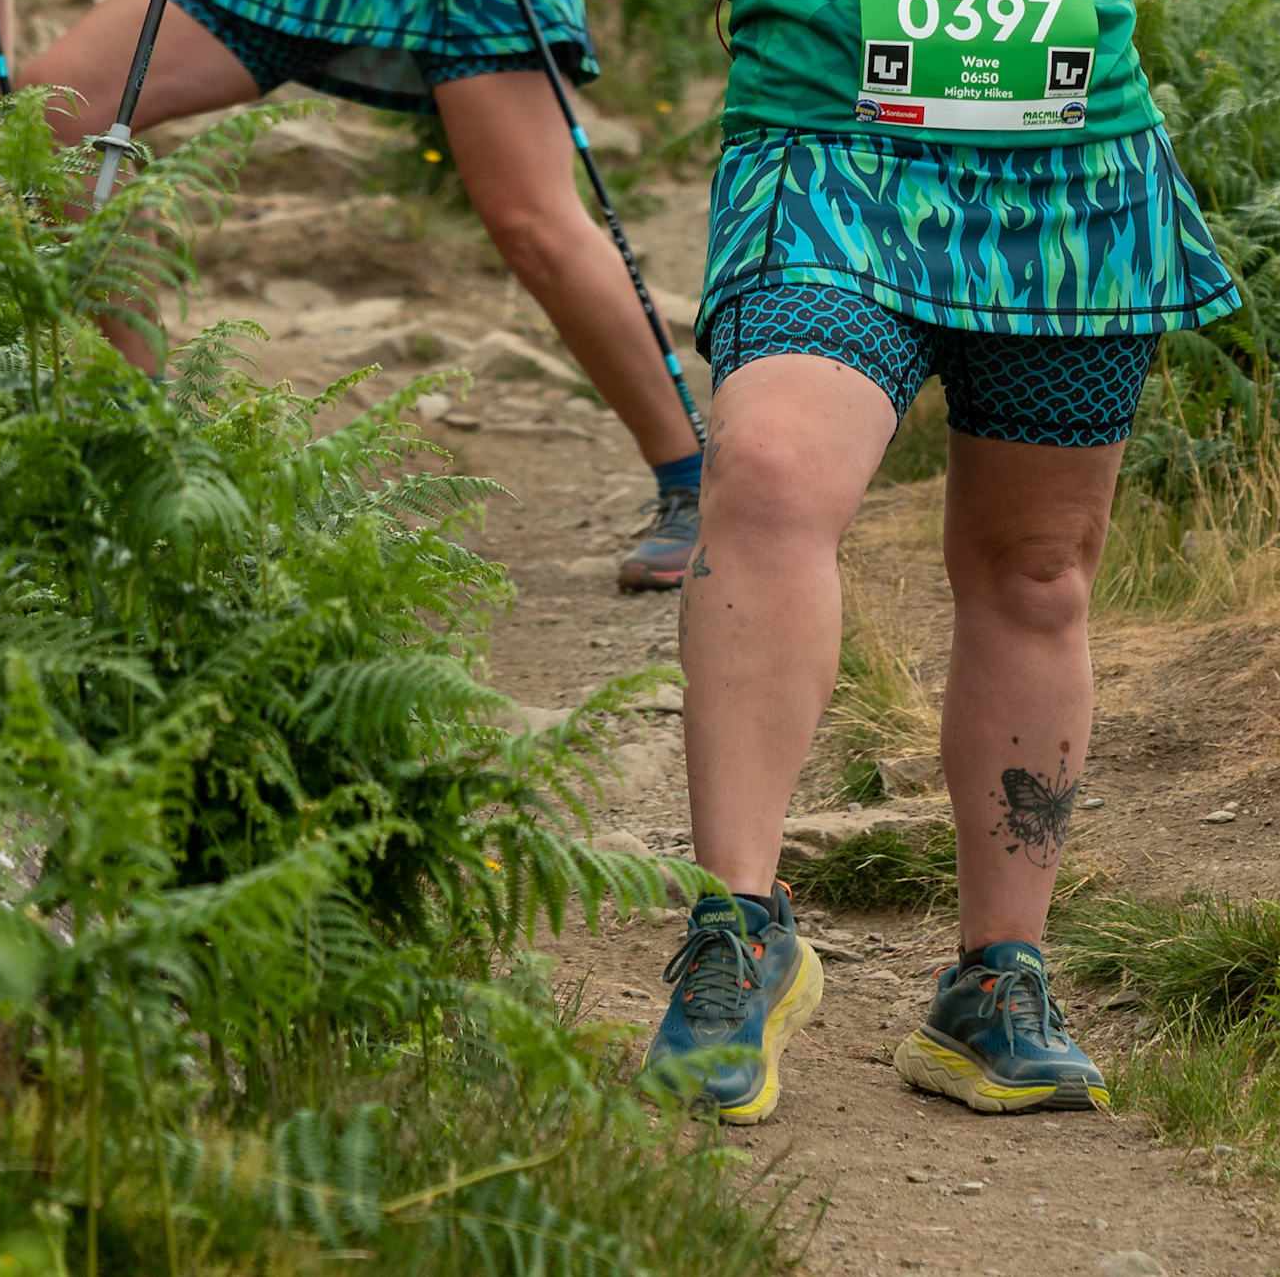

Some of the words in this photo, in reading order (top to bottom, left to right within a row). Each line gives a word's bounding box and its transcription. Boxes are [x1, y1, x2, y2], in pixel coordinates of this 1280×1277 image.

[961, 55, 1000, 69] Wave
[960, 71, 999, 85] 06:50
[944, 85, 982, 99] Mighty
[984, 87, 1014, 99] Hikes
[885, 109, 918, 119] Santander
[1022, 110, 1060, 120] MACMIL
